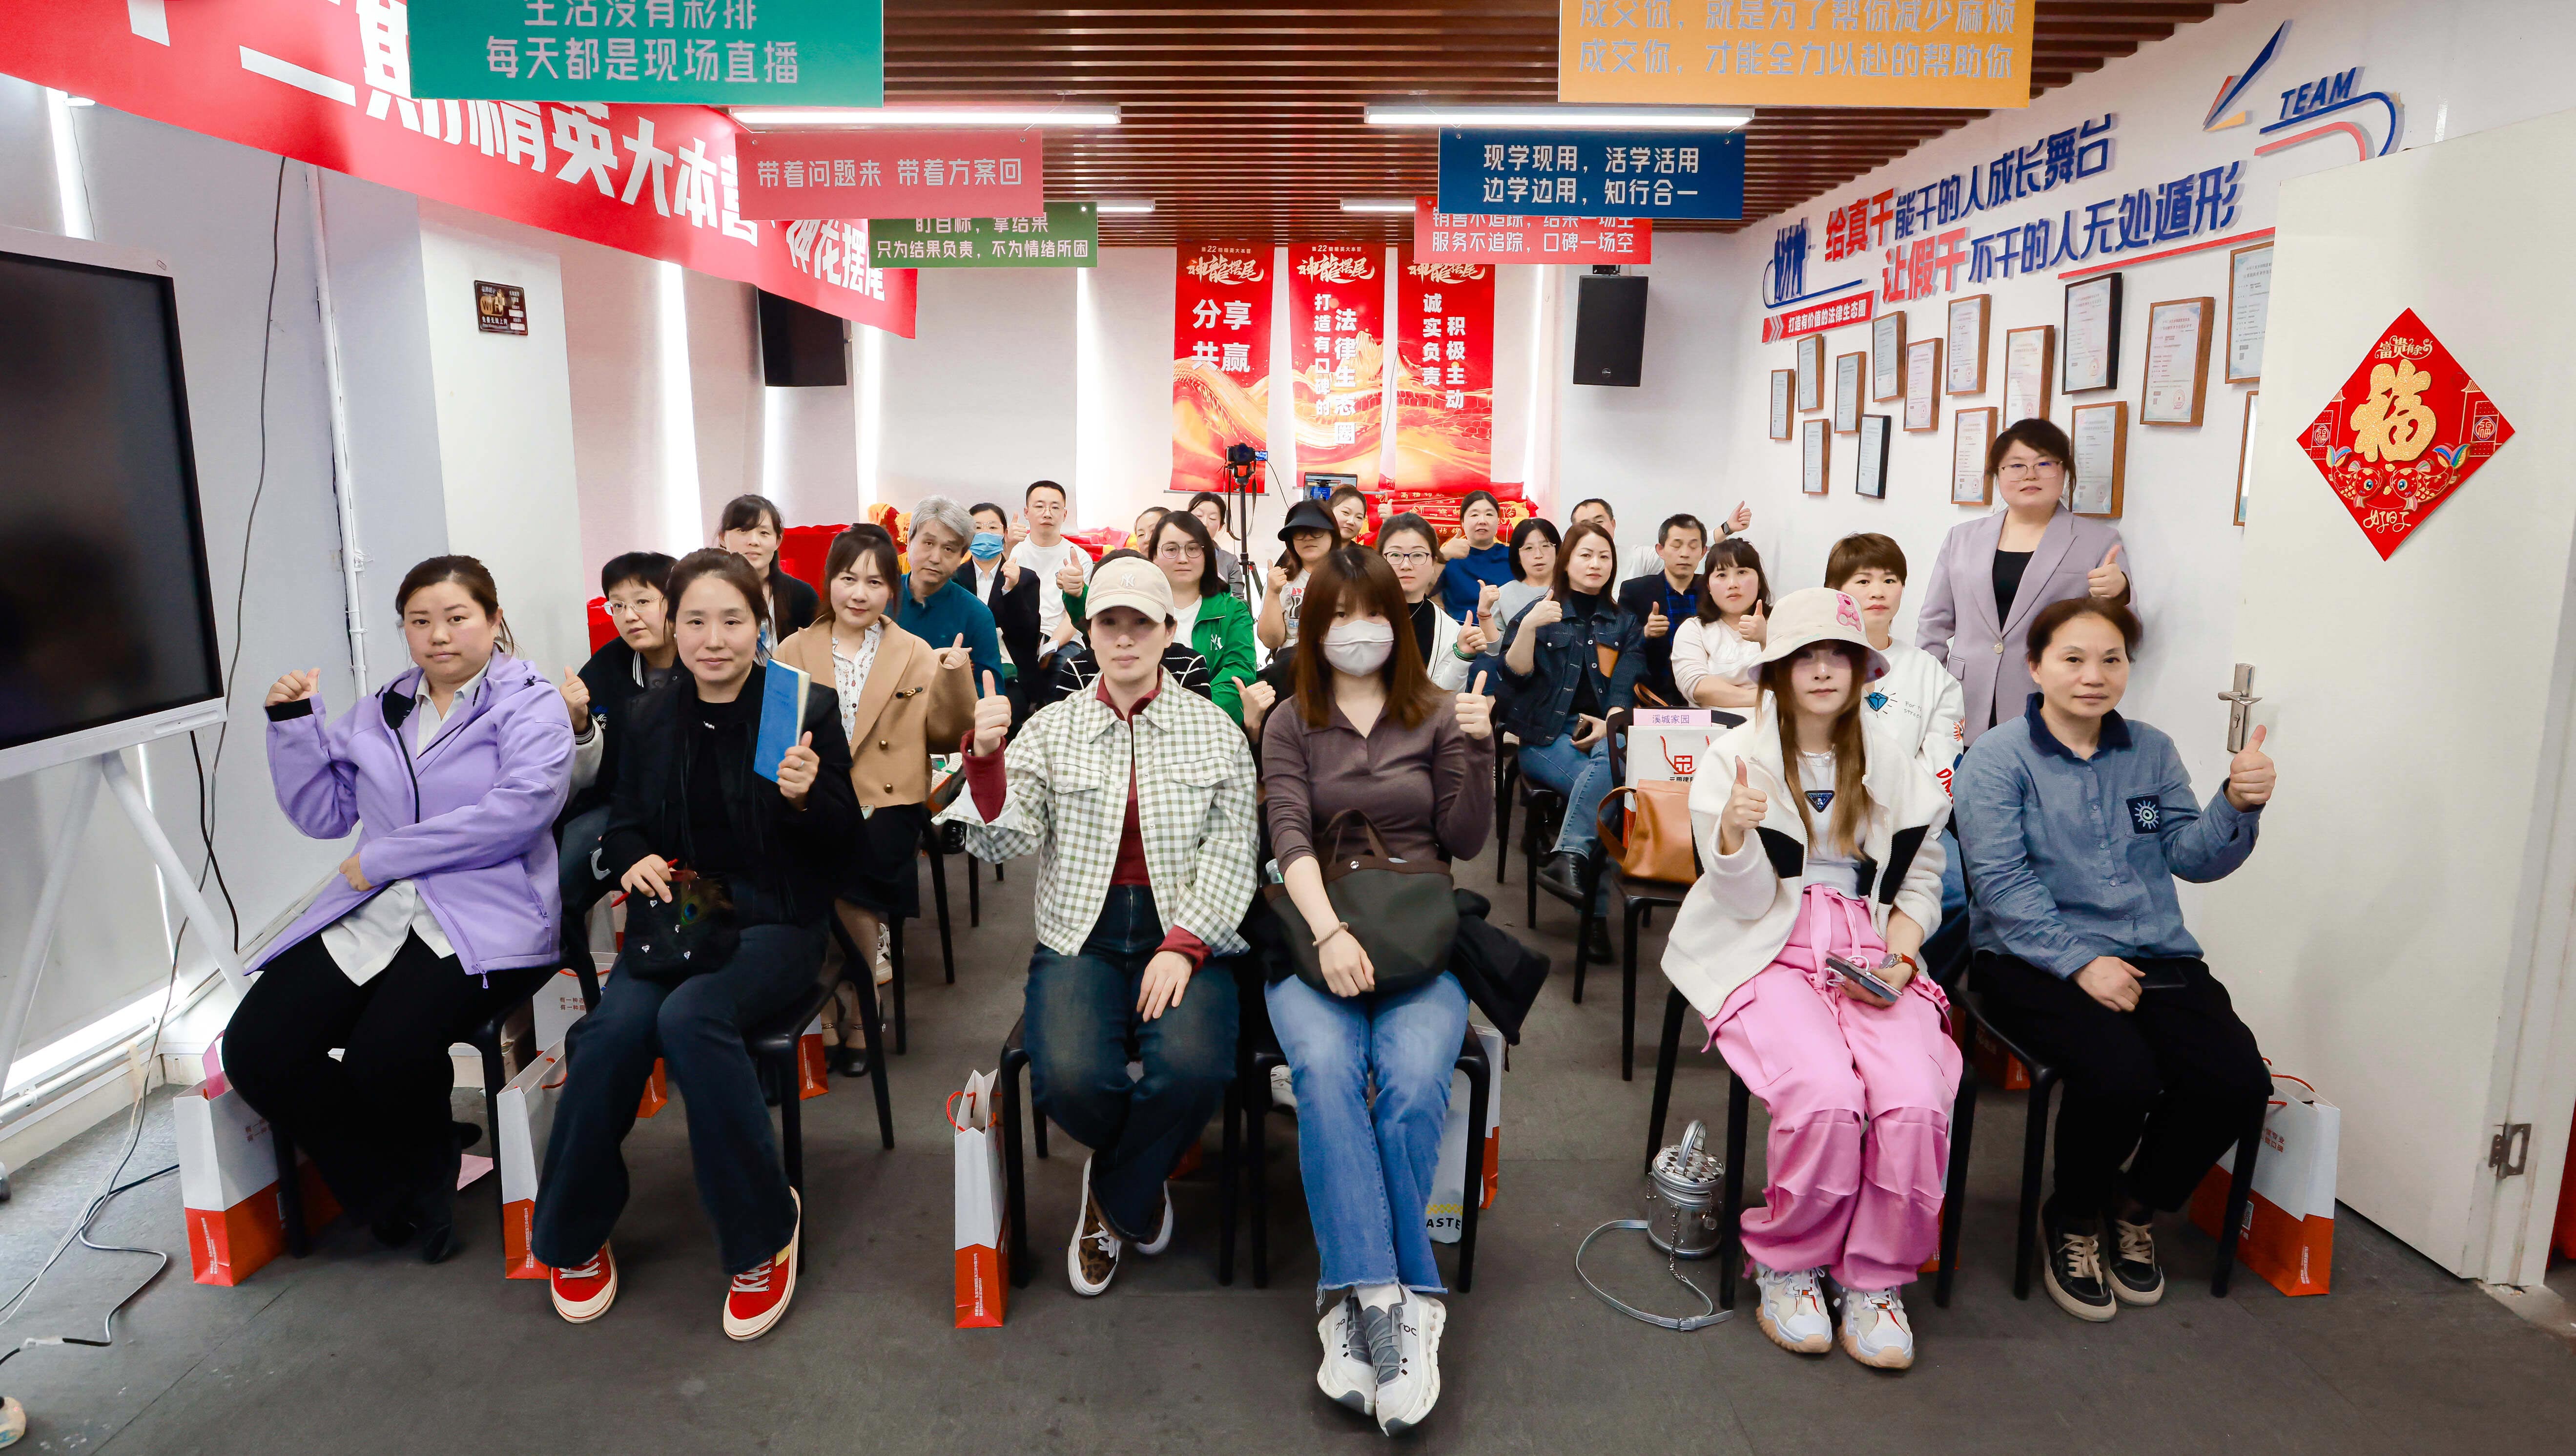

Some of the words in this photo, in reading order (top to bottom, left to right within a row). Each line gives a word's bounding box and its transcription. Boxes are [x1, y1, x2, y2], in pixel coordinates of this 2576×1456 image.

[487, 35, 798, 83] 每天都是现场直播
[1579, 38, 2013, 78] 成交你，才能全力以赴的帮助你
[2279, 67, 2357, 120] TEAM
[758, 159, 881, 187] 带着问题来
[897, 158, 1022, 186] 带着方案回
[1484, 145, 1699, 174] 现学现用，活学活用
[1483, 176, 1698, 206] 边学边用，知行合一
[1825, 113, 2111, 262] 给真干能干的人成长舞台
[877, 240, 1089, 259] 只为结果负责，不为情绪所困
[1432, 231, 1634, 253] 服务不追踪，口碑一场空
[1882, 161, 2241, 303] 让假干不干的人无处遁形
[1192, 299, 1252, 331] 分享
[1788, 299, 1867, 333] 打造有价值的法律生态圈
[1191, 340, 1251, 373] 共赢
[1314, 293, 1332, 416] 打造有口碑的
[1422, 293, 1443, 387] 诚实负责
[1334, 309, 1358, 444] 法律生态圈
[1445, 316, 1466, 410] 积极主动
[2350, 359, 2436, 462] 福
[1652, 714, 1690, 724] 溪城家园
